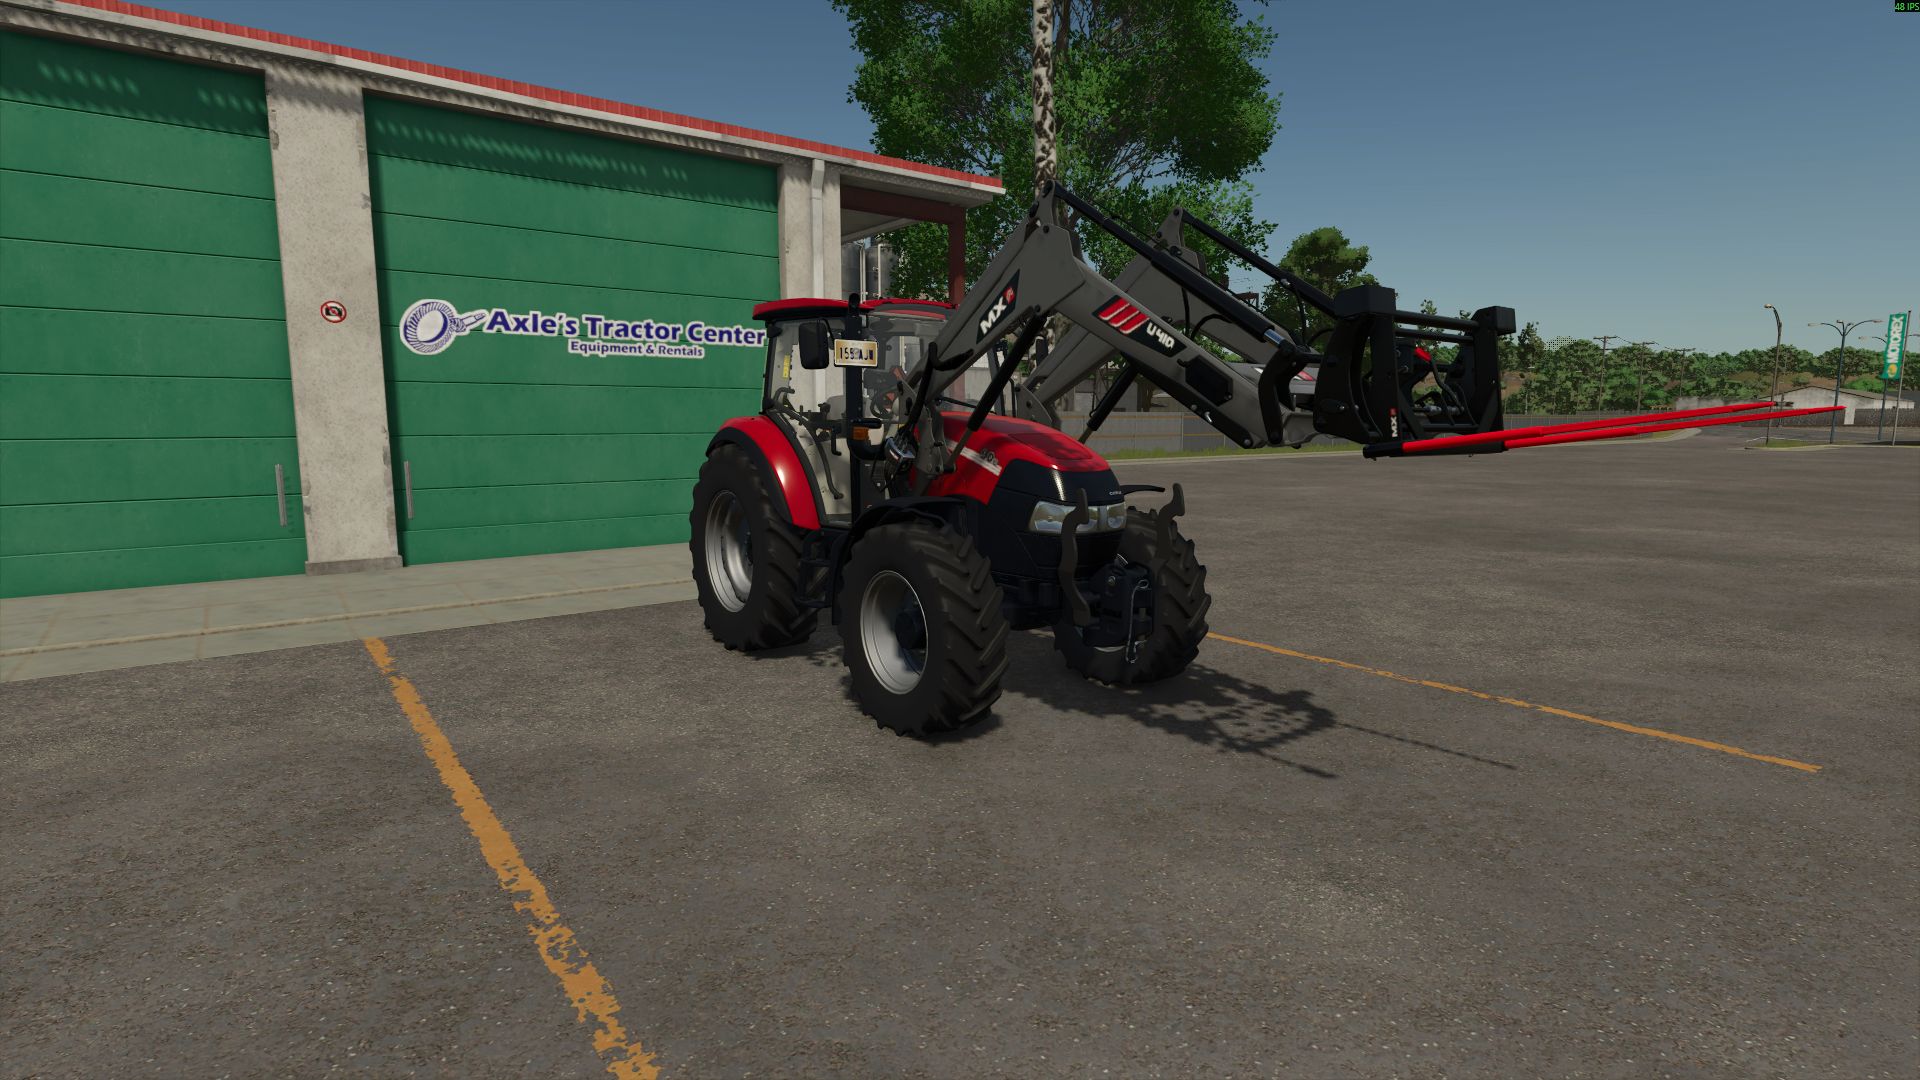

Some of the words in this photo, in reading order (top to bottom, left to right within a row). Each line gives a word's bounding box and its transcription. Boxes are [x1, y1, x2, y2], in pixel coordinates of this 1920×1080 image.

[485, 310, 577, 335] Axle's
[584, 316, 681, 340] Tractor
[688, 322, 765, 345] Center
[980, 296, 1007, 335] MX
[571, 341, 643, 356] Equipment
[646, 344, 655, 354] &
[658, 345, 703, 357] Rentals
[1886, 316, 1904, 363] MOTOREX
[1390, 416, 1398, 437] MX
